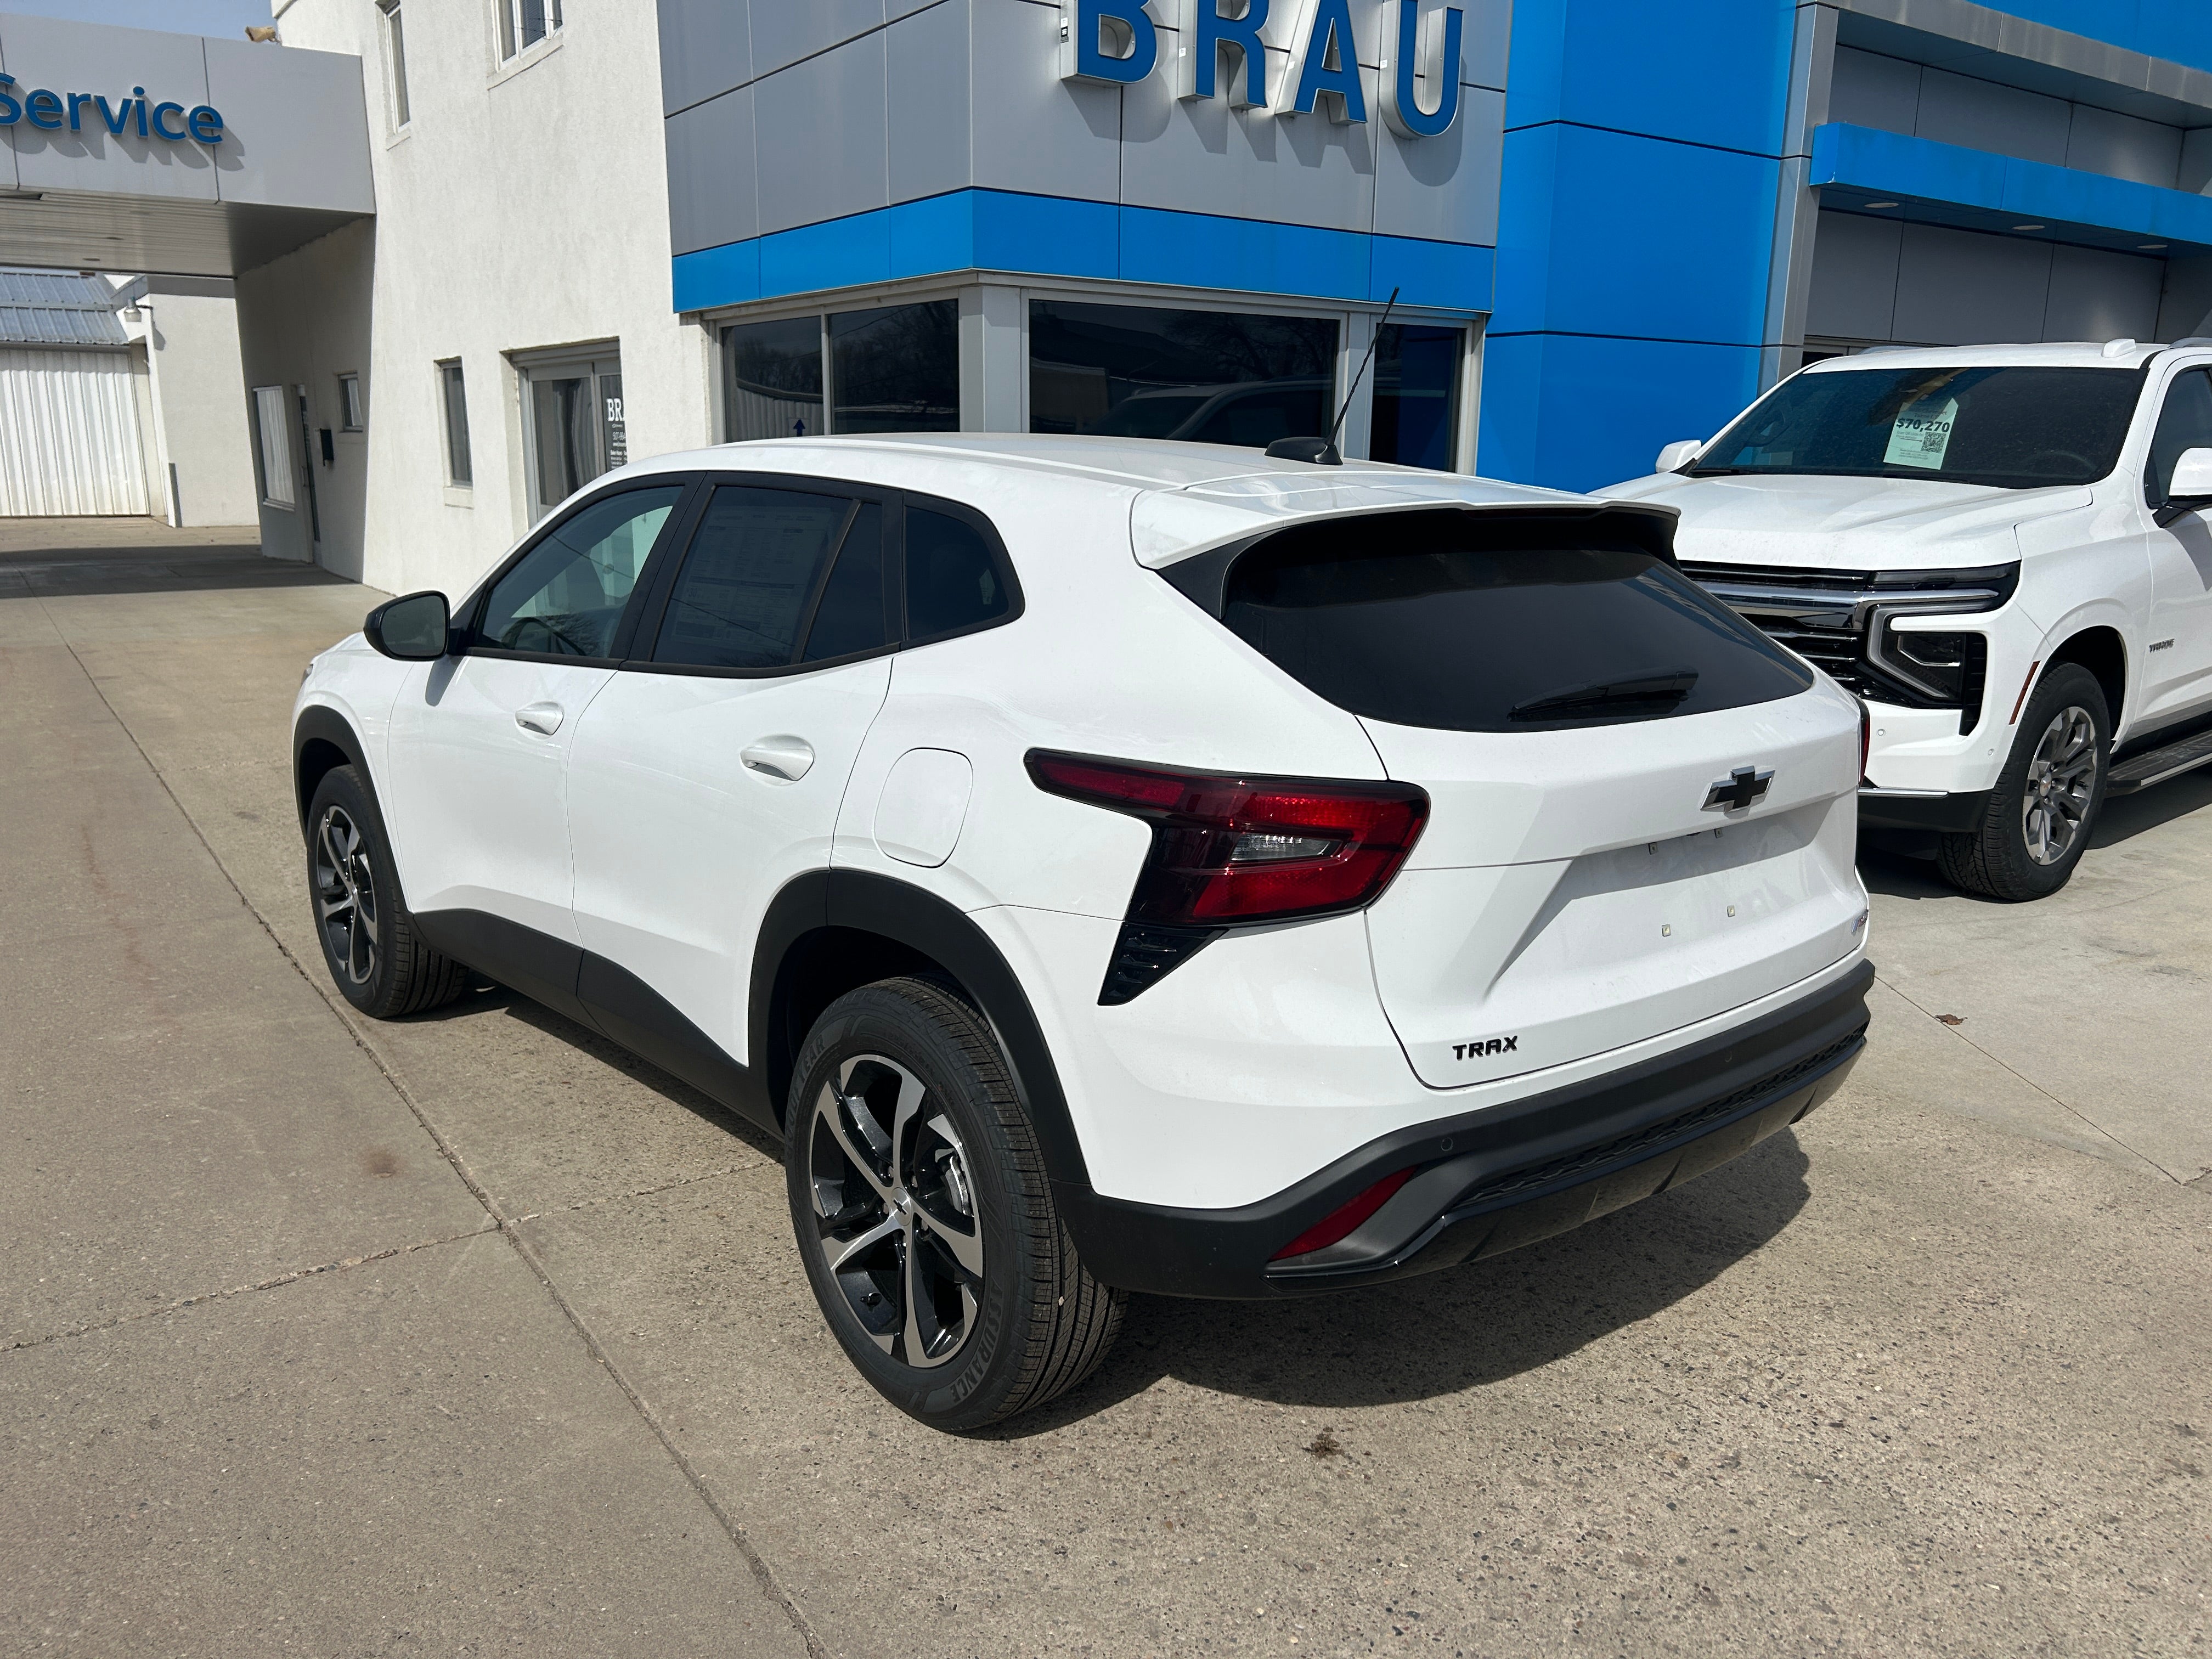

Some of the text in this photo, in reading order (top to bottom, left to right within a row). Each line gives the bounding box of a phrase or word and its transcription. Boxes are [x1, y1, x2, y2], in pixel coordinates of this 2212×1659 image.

[1073, 0, 1464, 137] BRAU
[0, 72, 224, 144] Service
[607, 398, 625, 421] BR
[1895, 417, 1950, 432] $70,270
[1452, 1035, 1518, 1060] TRAX
[949, 1276, 1003, 1403] ASSURANCE
